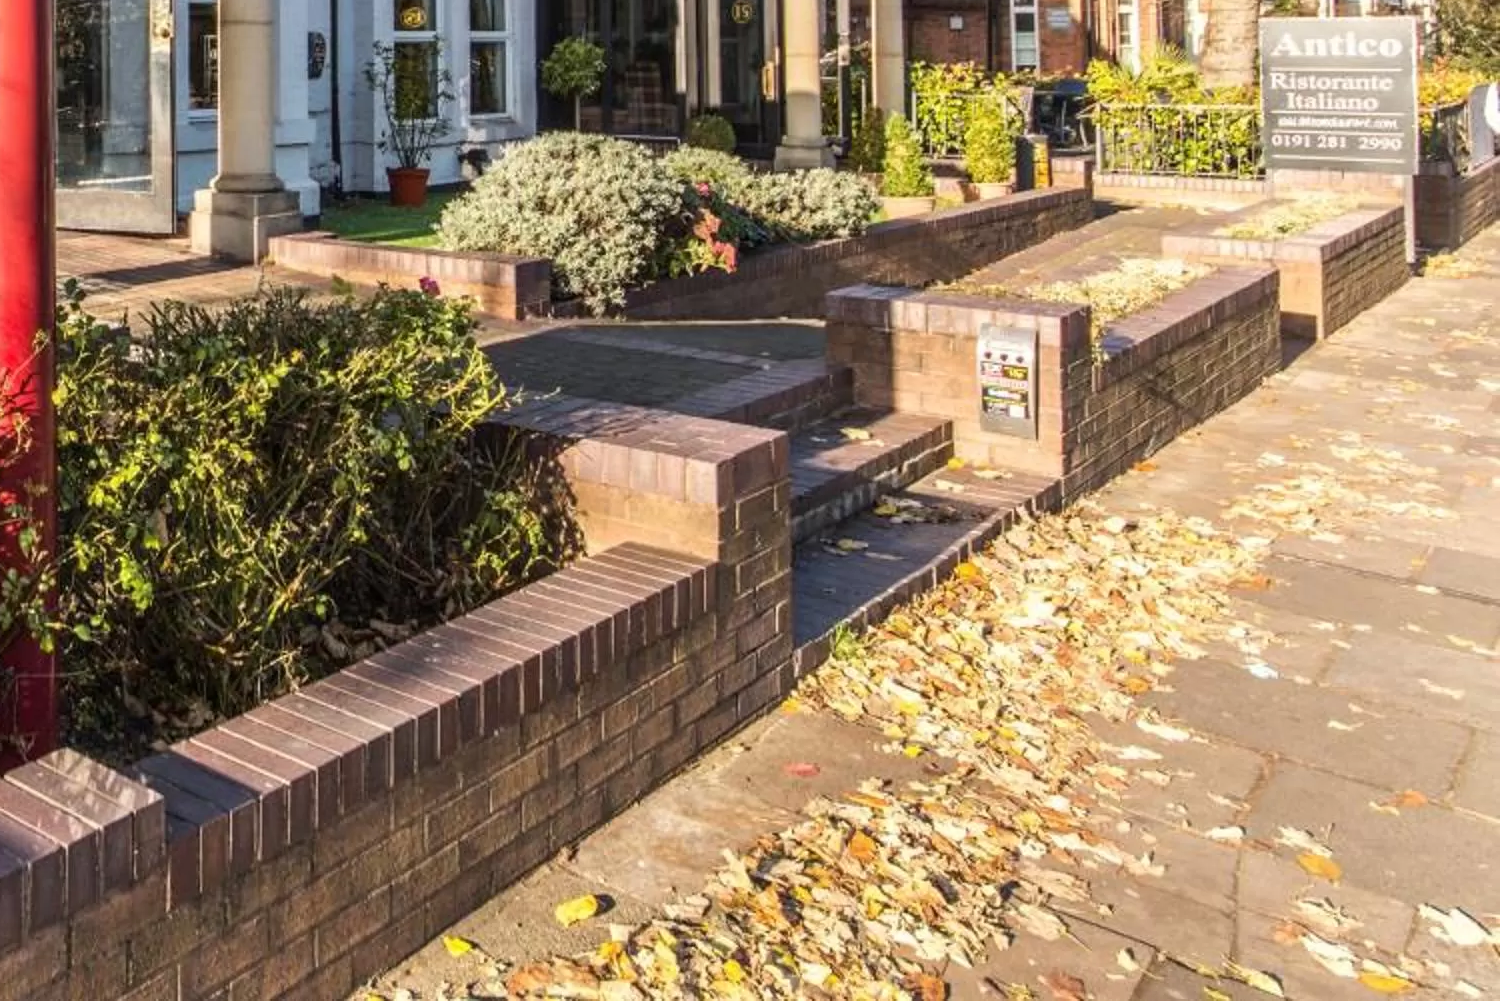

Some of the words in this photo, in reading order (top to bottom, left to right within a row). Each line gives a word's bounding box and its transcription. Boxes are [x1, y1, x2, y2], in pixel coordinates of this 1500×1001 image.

[1270, 31, 1403, 57] Antico
[1270, 72, 1394, 91] Ristorante
[1286, 92, 1379, 111] Italiano
[1271, 134, 1311, 148] 0191
[1316, 135, 1347, 148] 281
[1358, 137, 1402, 151] 2990
